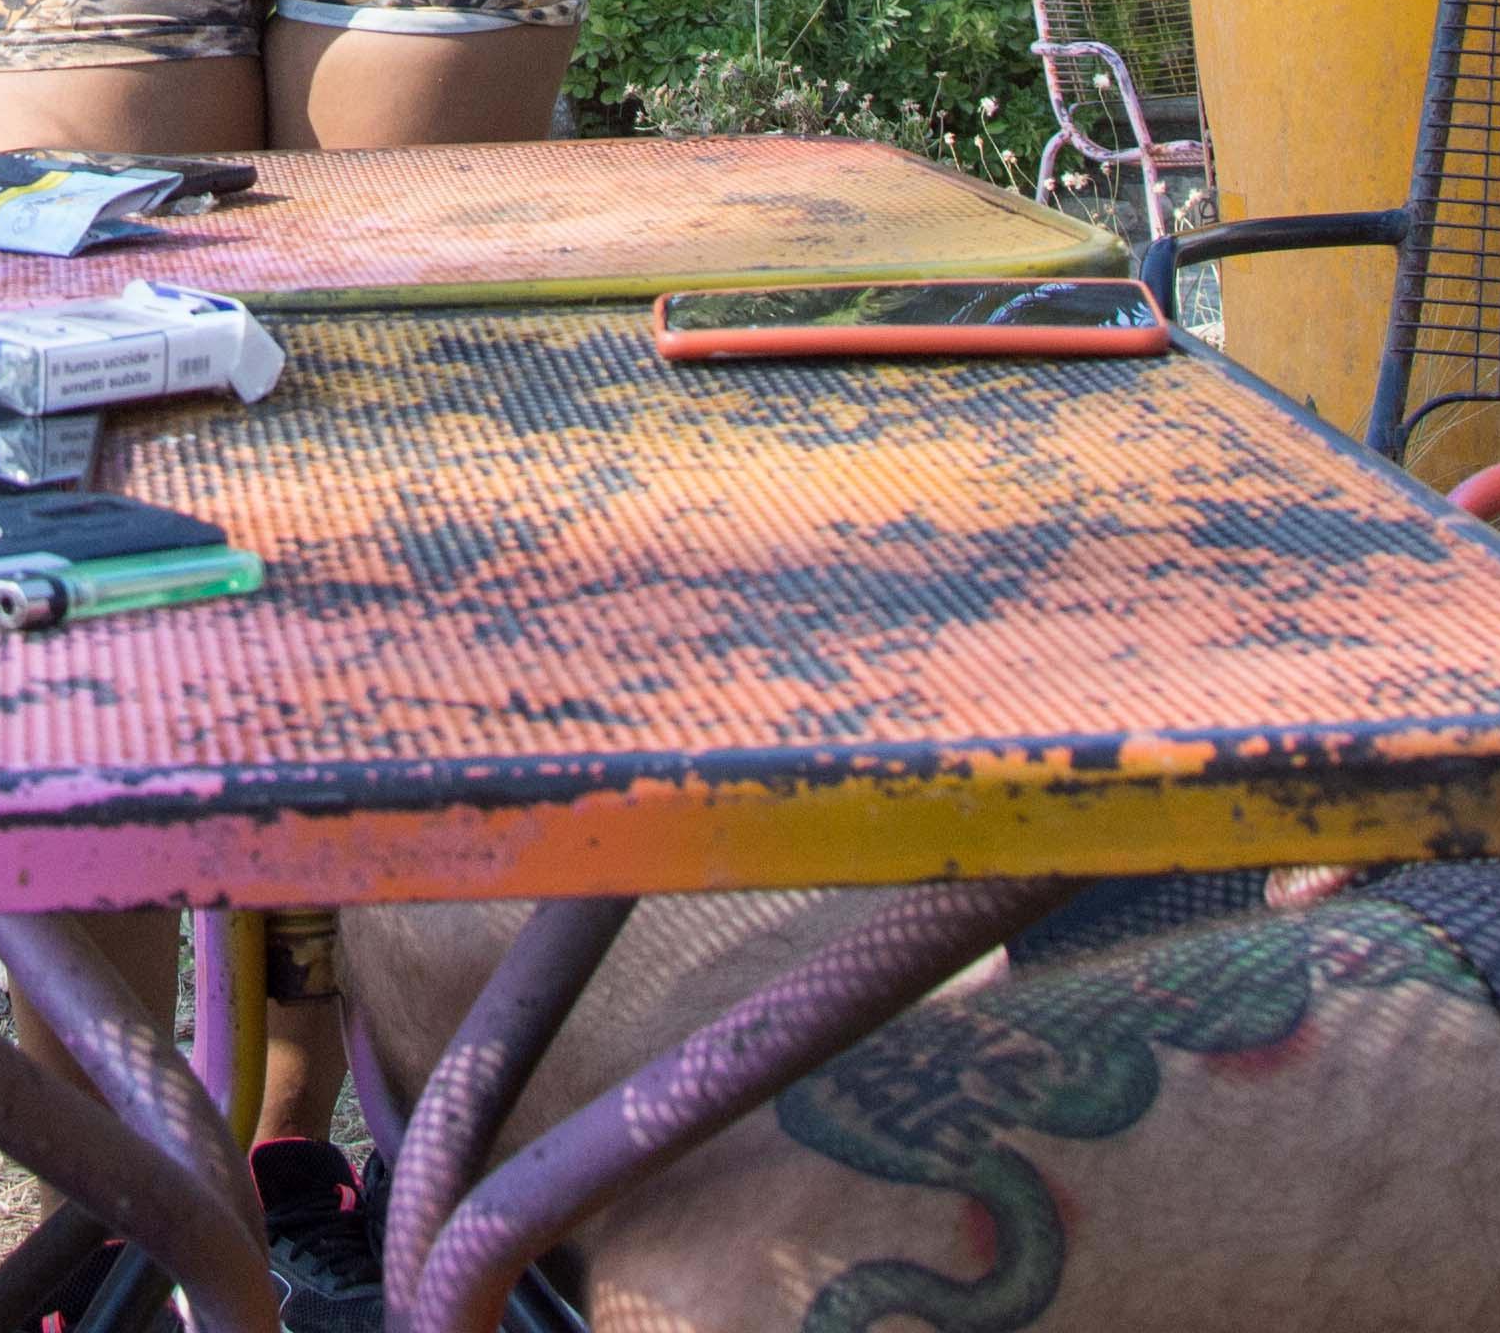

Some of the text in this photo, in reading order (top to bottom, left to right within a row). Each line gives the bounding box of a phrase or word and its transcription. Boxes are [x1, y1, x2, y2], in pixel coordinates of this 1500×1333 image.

[63, 355, 100, 376] fumo
[103, 348, 150, 370] uccide
[60, 370, 152, 397] smetti subito
